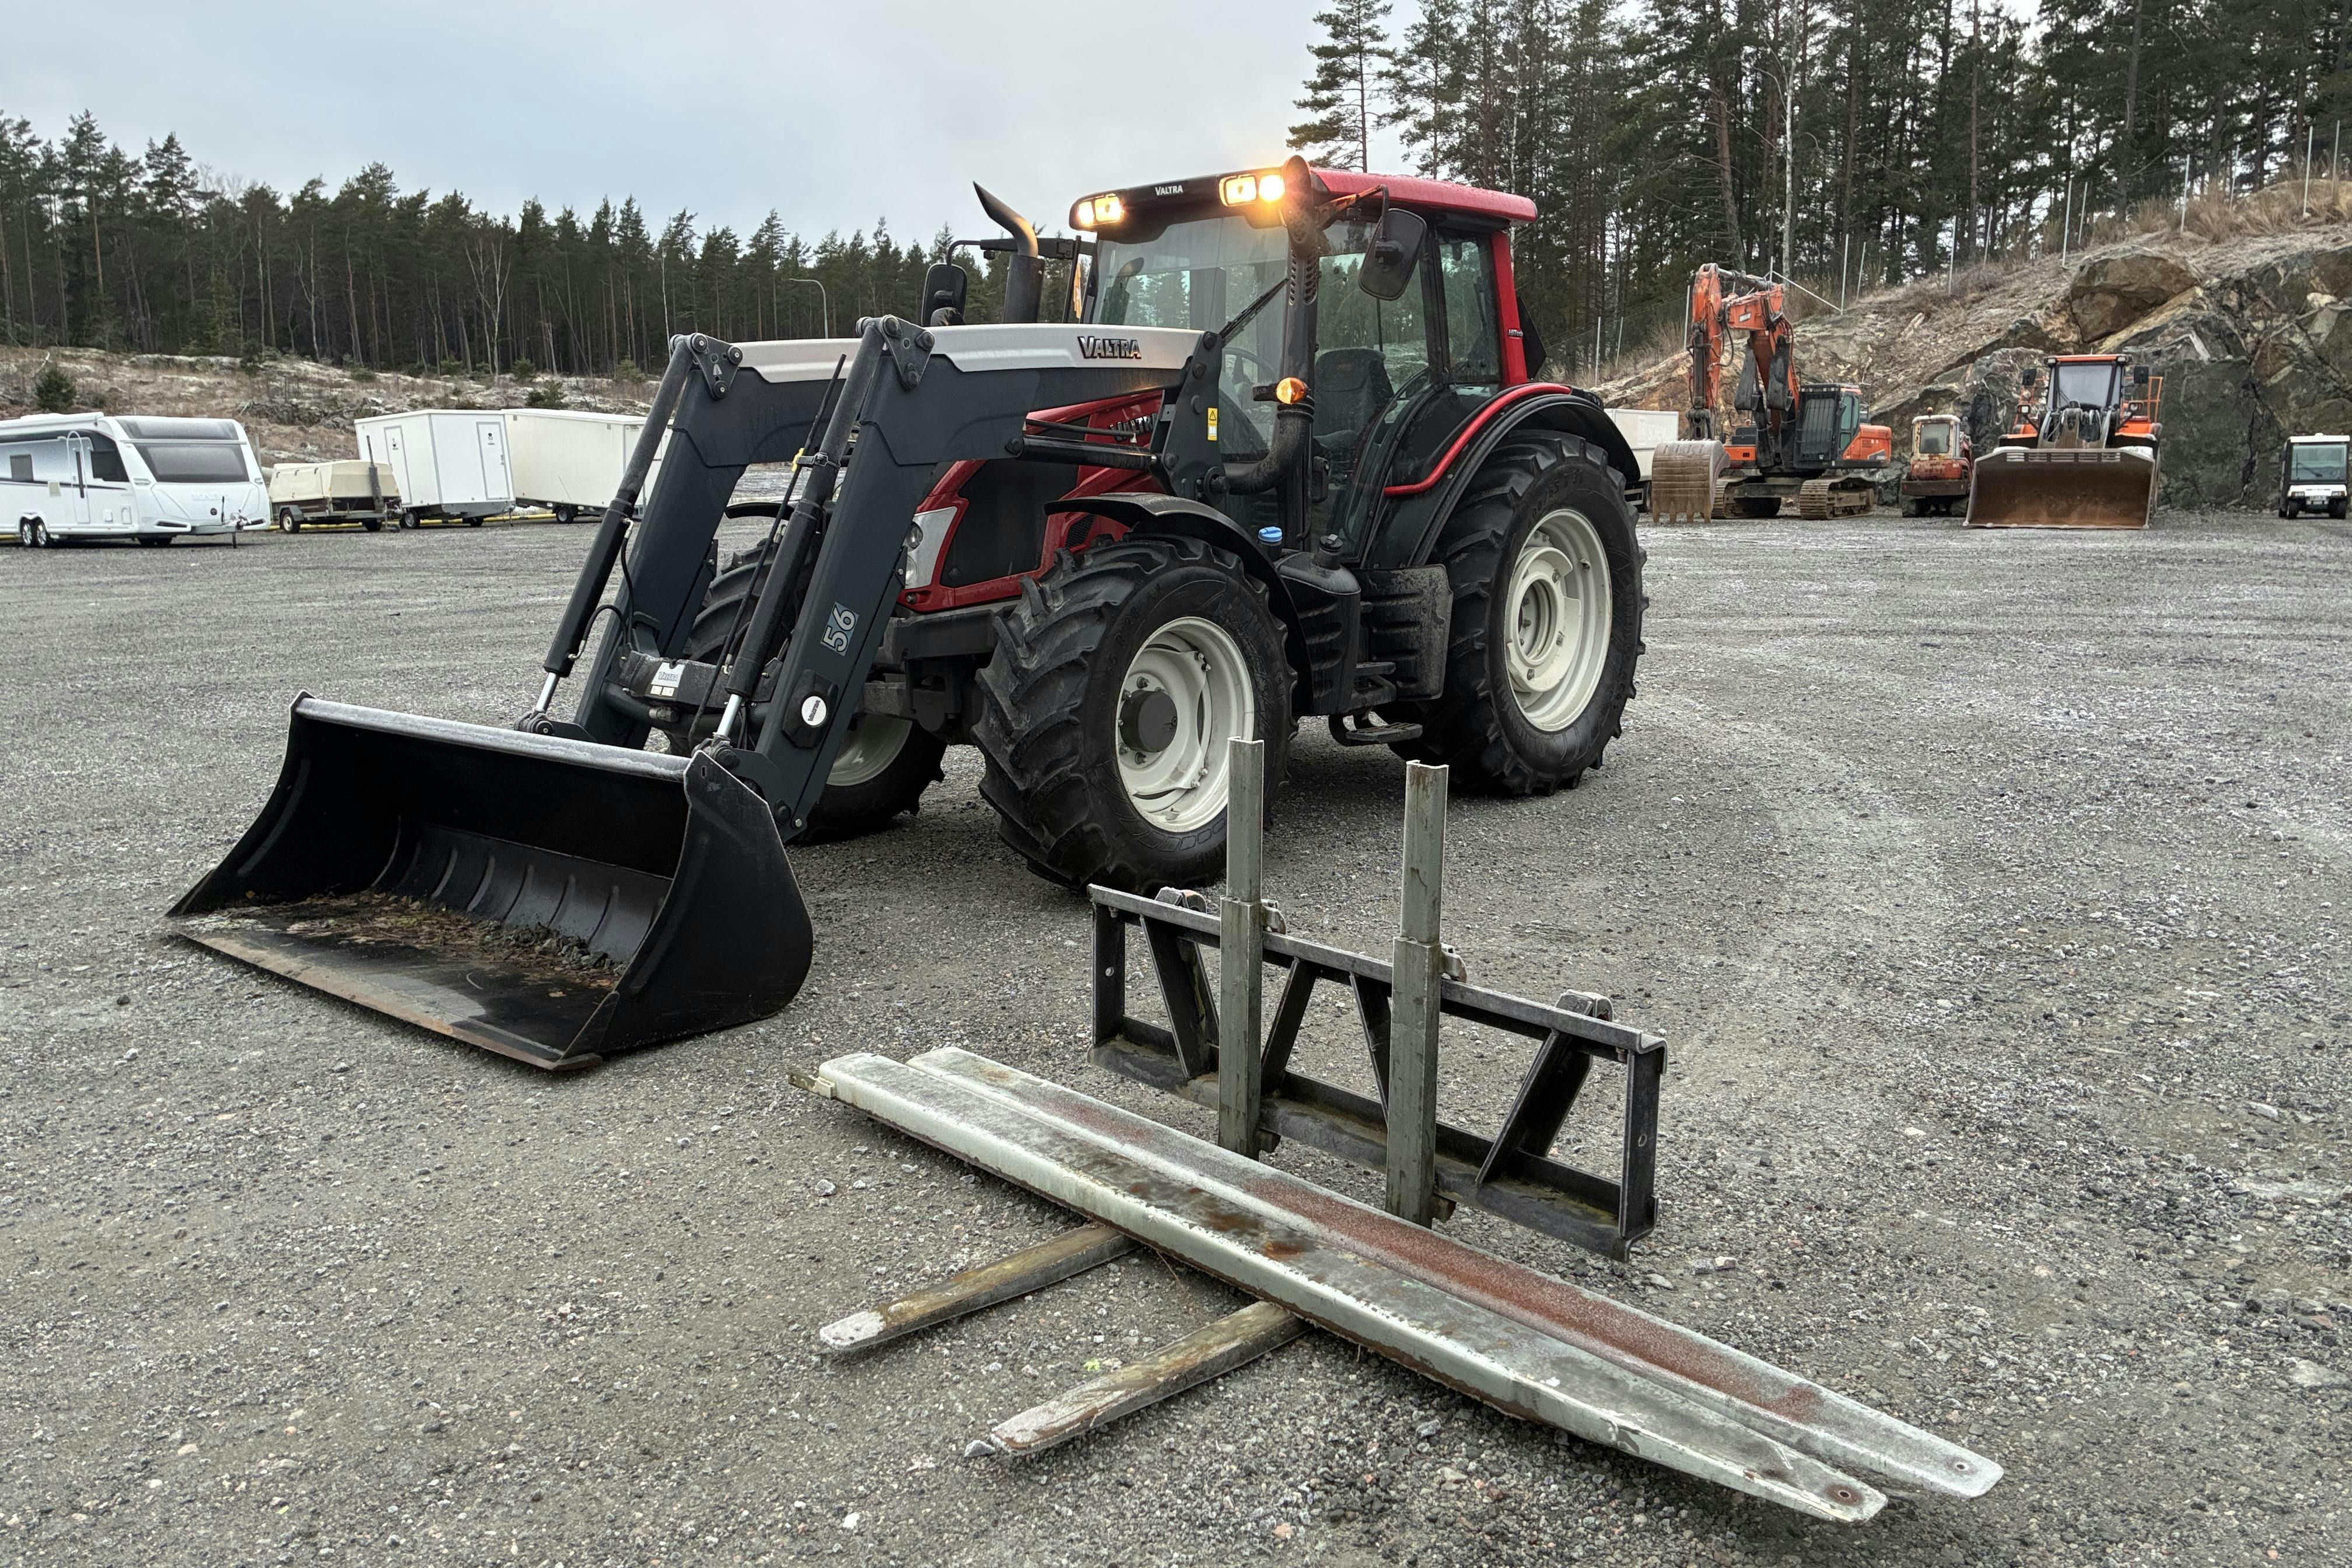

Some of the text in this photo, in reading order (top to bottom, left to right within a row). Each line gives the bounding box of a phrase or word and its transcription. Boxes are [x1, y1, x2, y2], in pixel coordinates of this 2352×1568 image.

[1155, 185, 1183, 195] VALTRA
[1077, 336, 1142, 359] VALTRA
[822, 604, 856, 652] 56
